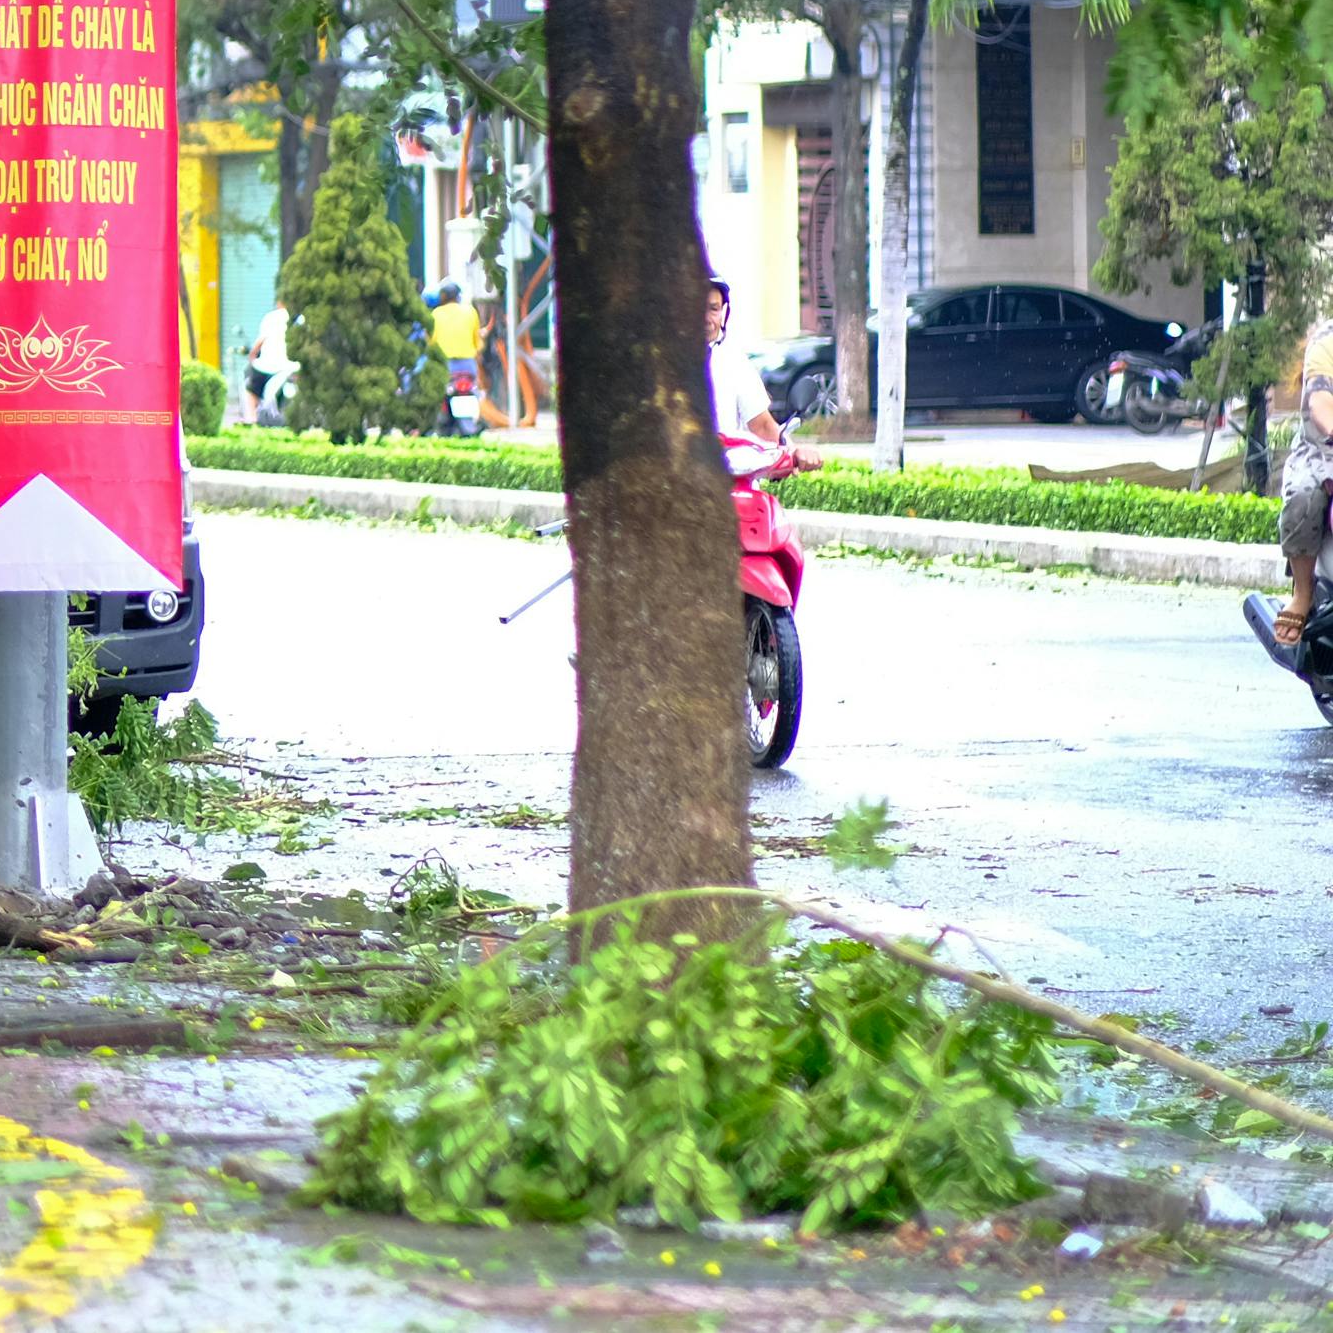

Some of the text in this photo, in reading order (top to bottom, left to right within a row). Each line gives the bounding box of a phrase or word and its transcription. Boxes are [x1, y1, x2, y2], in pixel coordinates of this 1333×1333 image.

[132, 0, 156, 54] LÀ
[42, 75, 103, 127] NGĂN
[109, 76, 165, 139] CHẶN
[34, 150, 77, 204] TRỪ
[81, 160, 138, 205] NGUY
[13, 226, 71, 287] CHÁY,
[77, 220, 109, 283] NỔ
